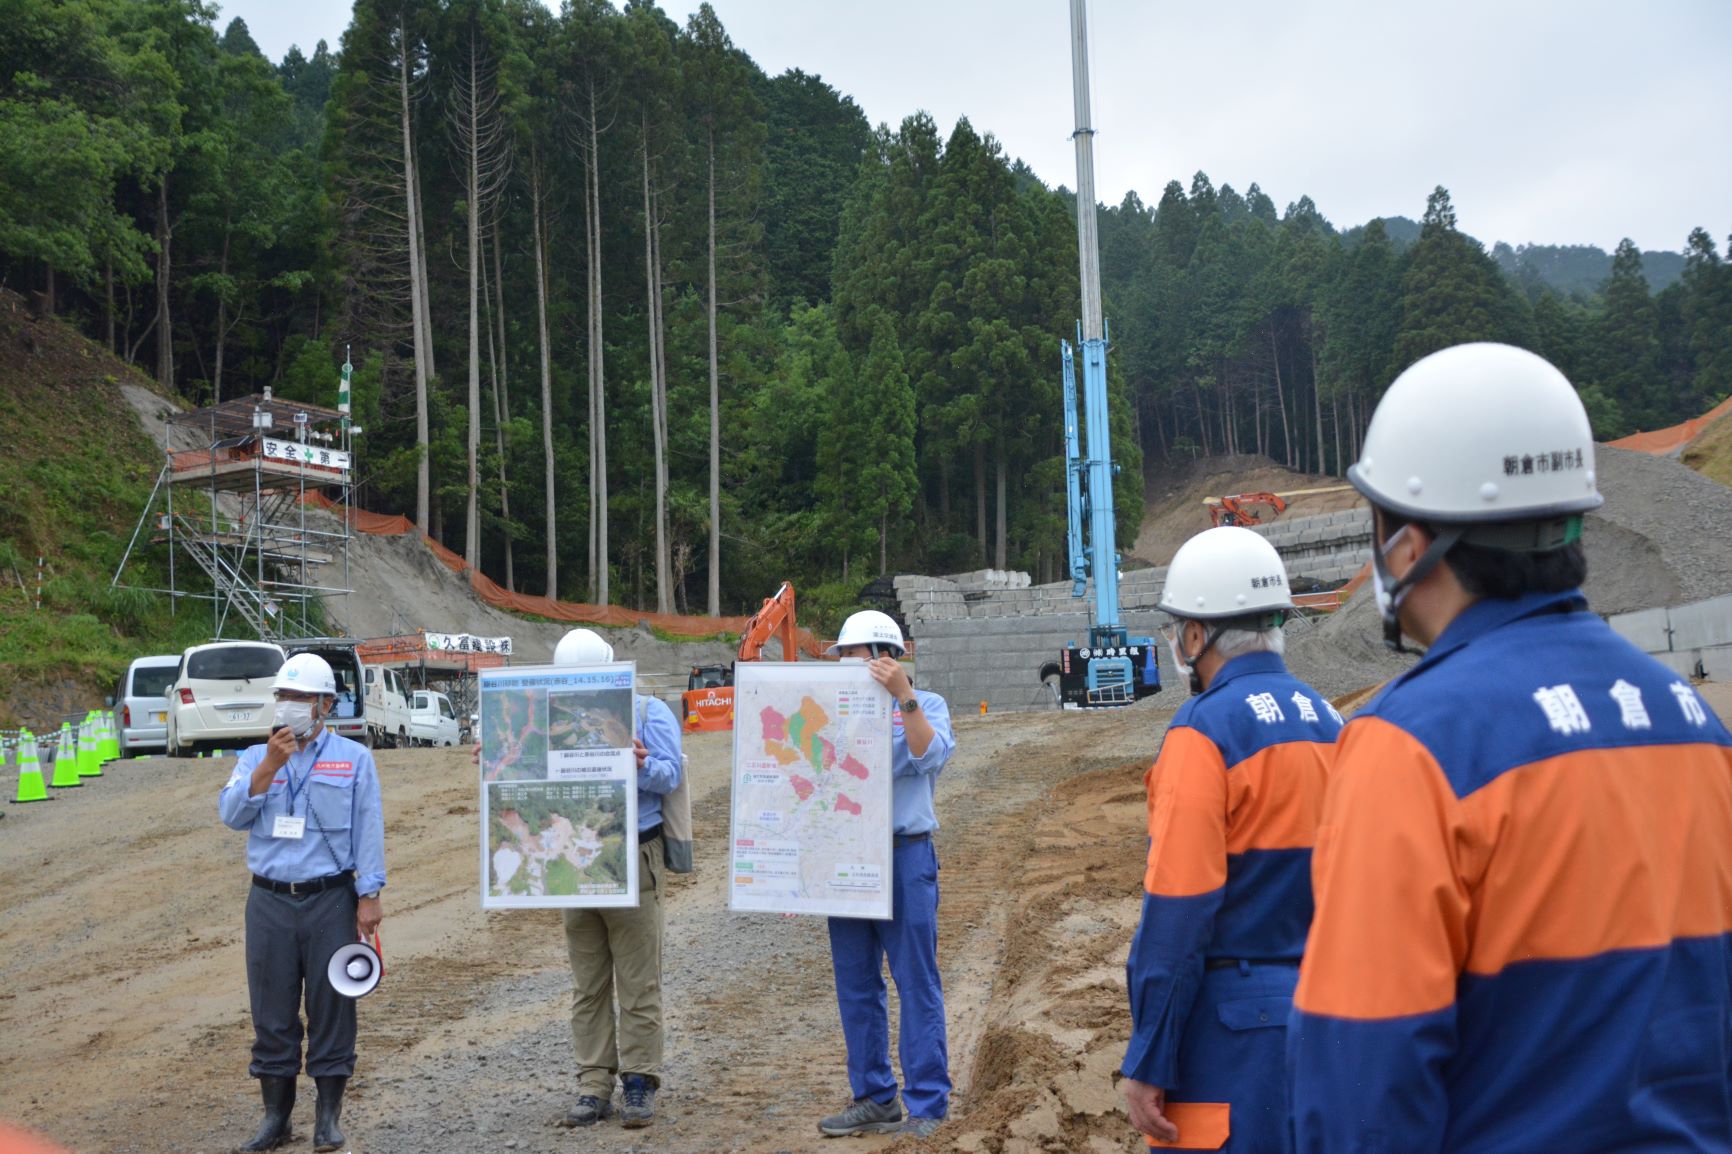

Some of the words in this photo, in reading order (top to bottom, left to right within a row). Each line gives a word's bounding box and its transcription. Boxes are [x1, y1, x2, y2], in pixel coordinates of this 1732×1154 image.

[1502, 447, 1584, 476] 朝倉市副市長
[1251, 574, 1282, 588] 朝倉市長
[695, 697, 732, 708] HITACHI
[1531, 677, 1708, 736] 朝倉市
